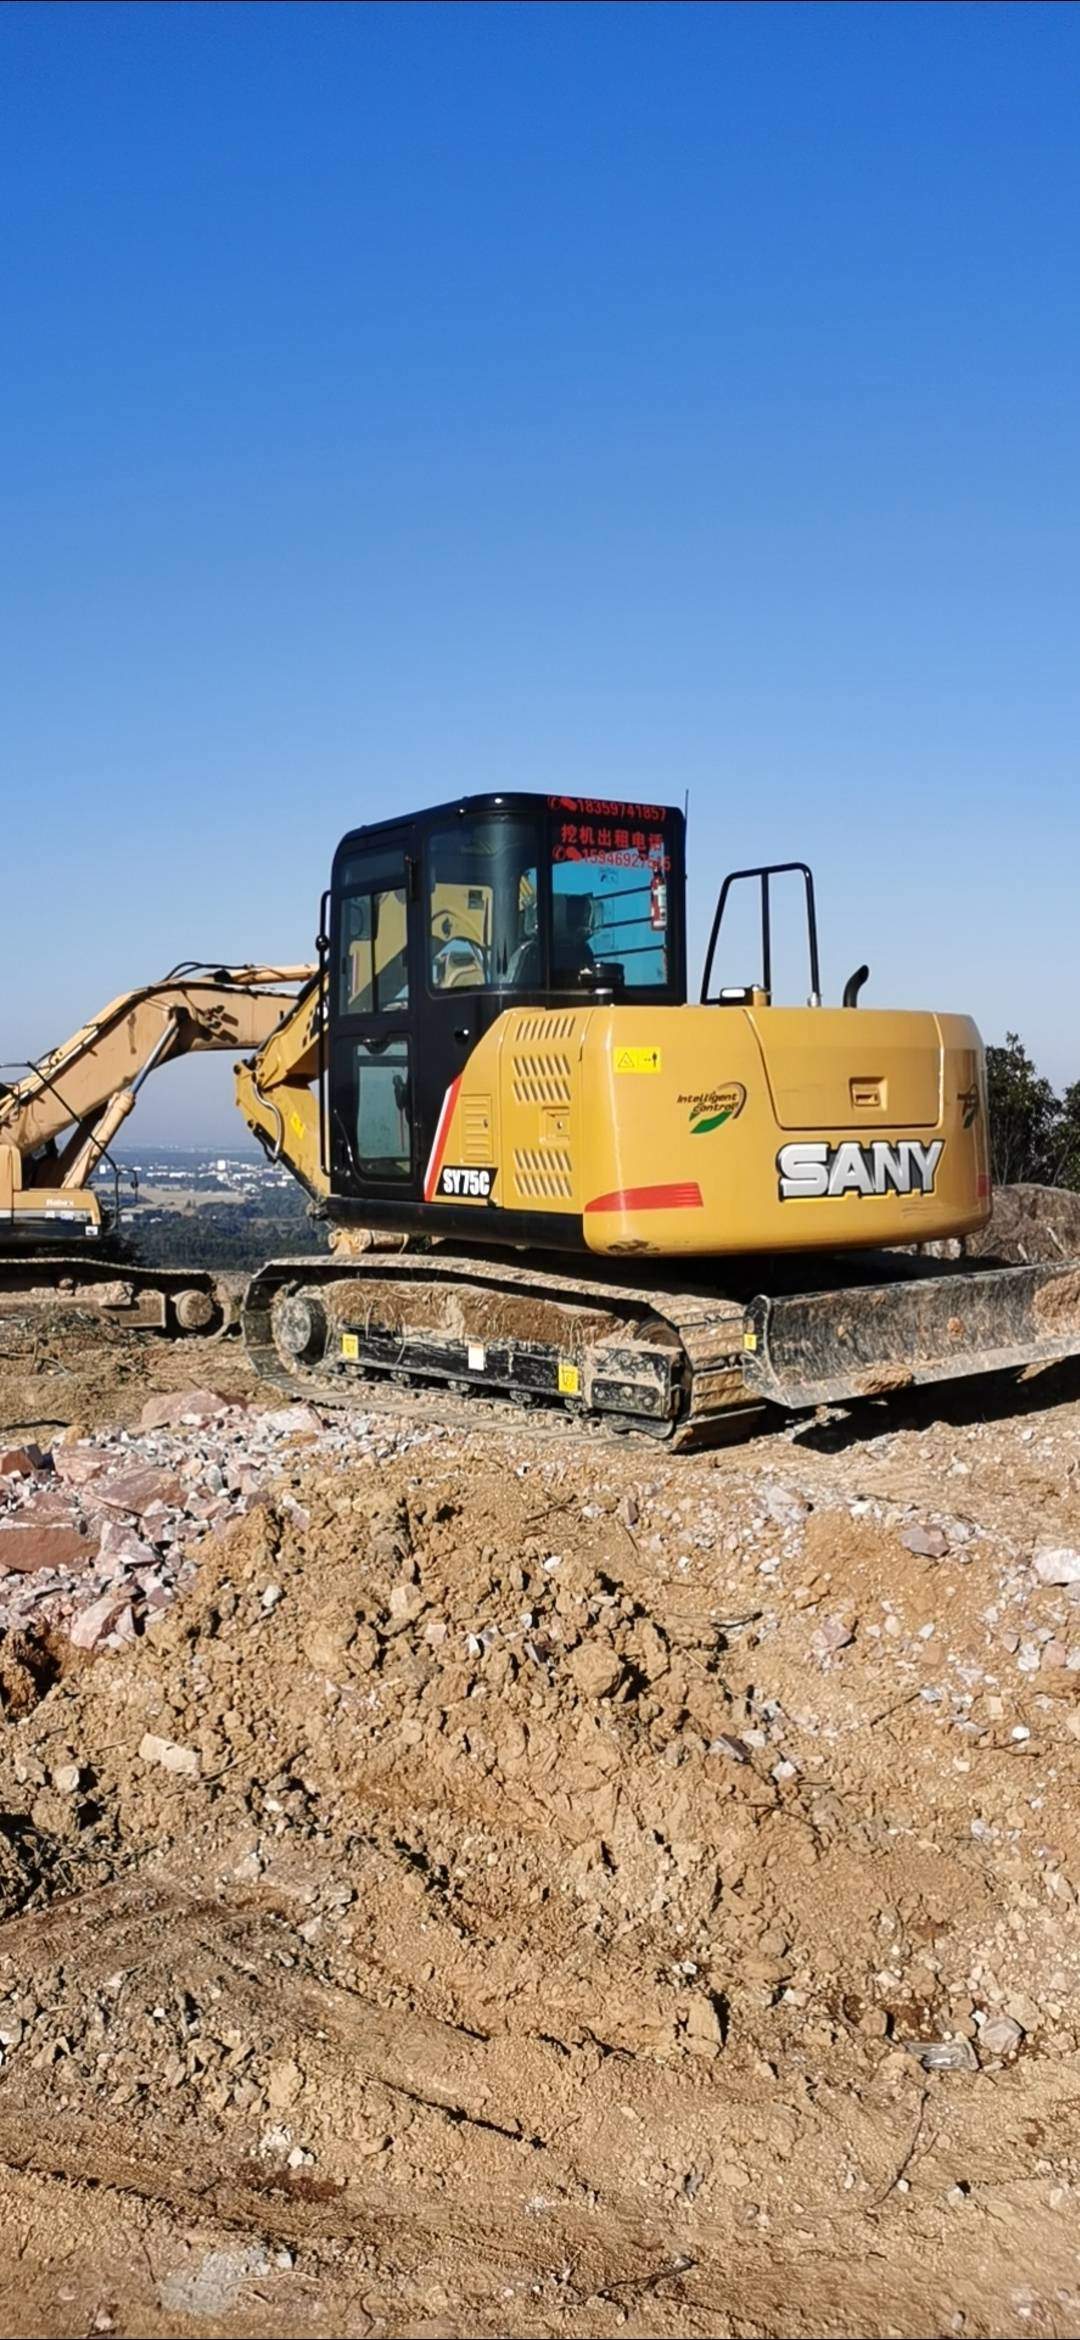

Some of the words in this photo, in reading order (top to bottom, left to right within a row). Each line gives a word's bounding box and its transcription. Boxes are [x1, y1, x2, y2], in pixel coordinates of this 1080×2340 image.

[578, 799, 667, 821] 18359741857
[561, 824, 663, 851] 挖机出租电话
[677, 1091, 737, 1104] Intelligent
[443, 1168, 490, 1195] SY75C
[776, 1140, 945, 1200] SANY
